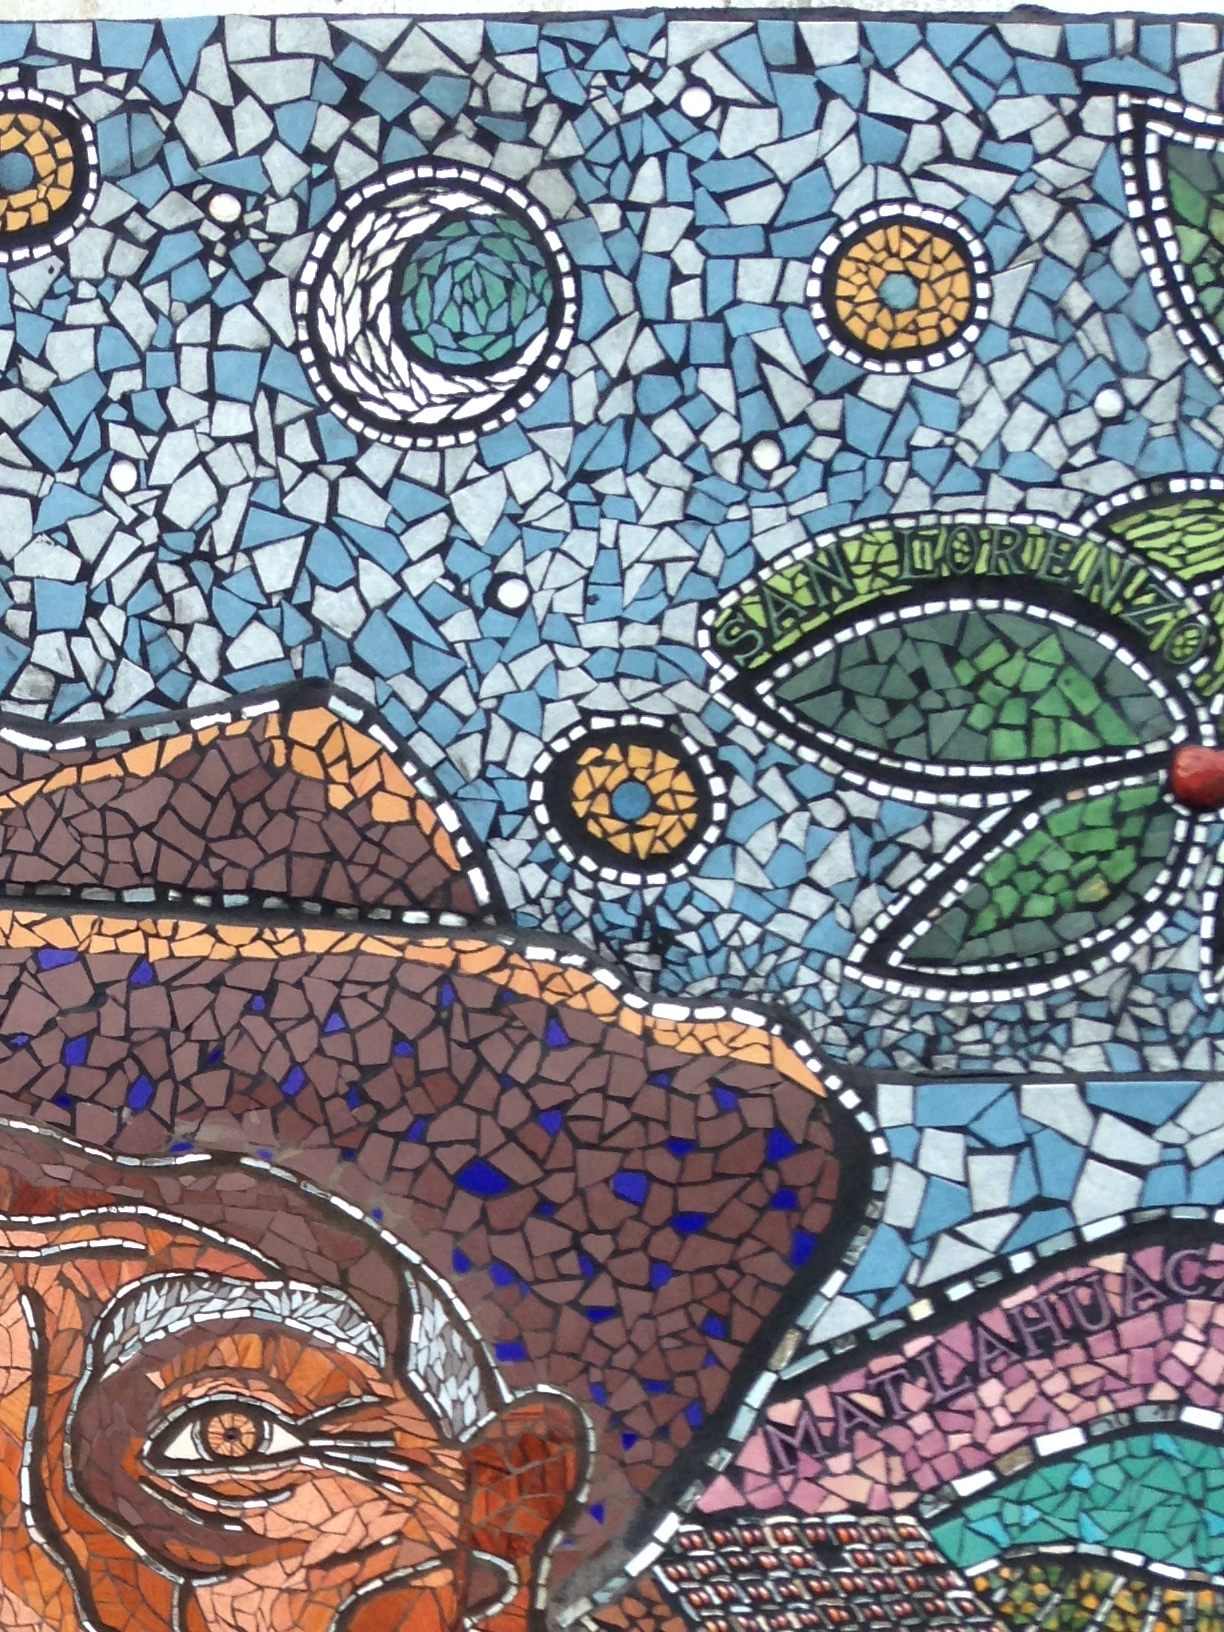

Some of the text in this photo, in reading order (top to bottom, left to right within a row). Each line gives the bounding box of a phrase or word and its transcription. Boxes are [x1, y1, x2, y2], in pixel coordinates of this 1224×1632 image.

[716, 526, 1209, 665] SAN LORENZO
[765, 1247, 1224, 1474] MATLAHUAC
